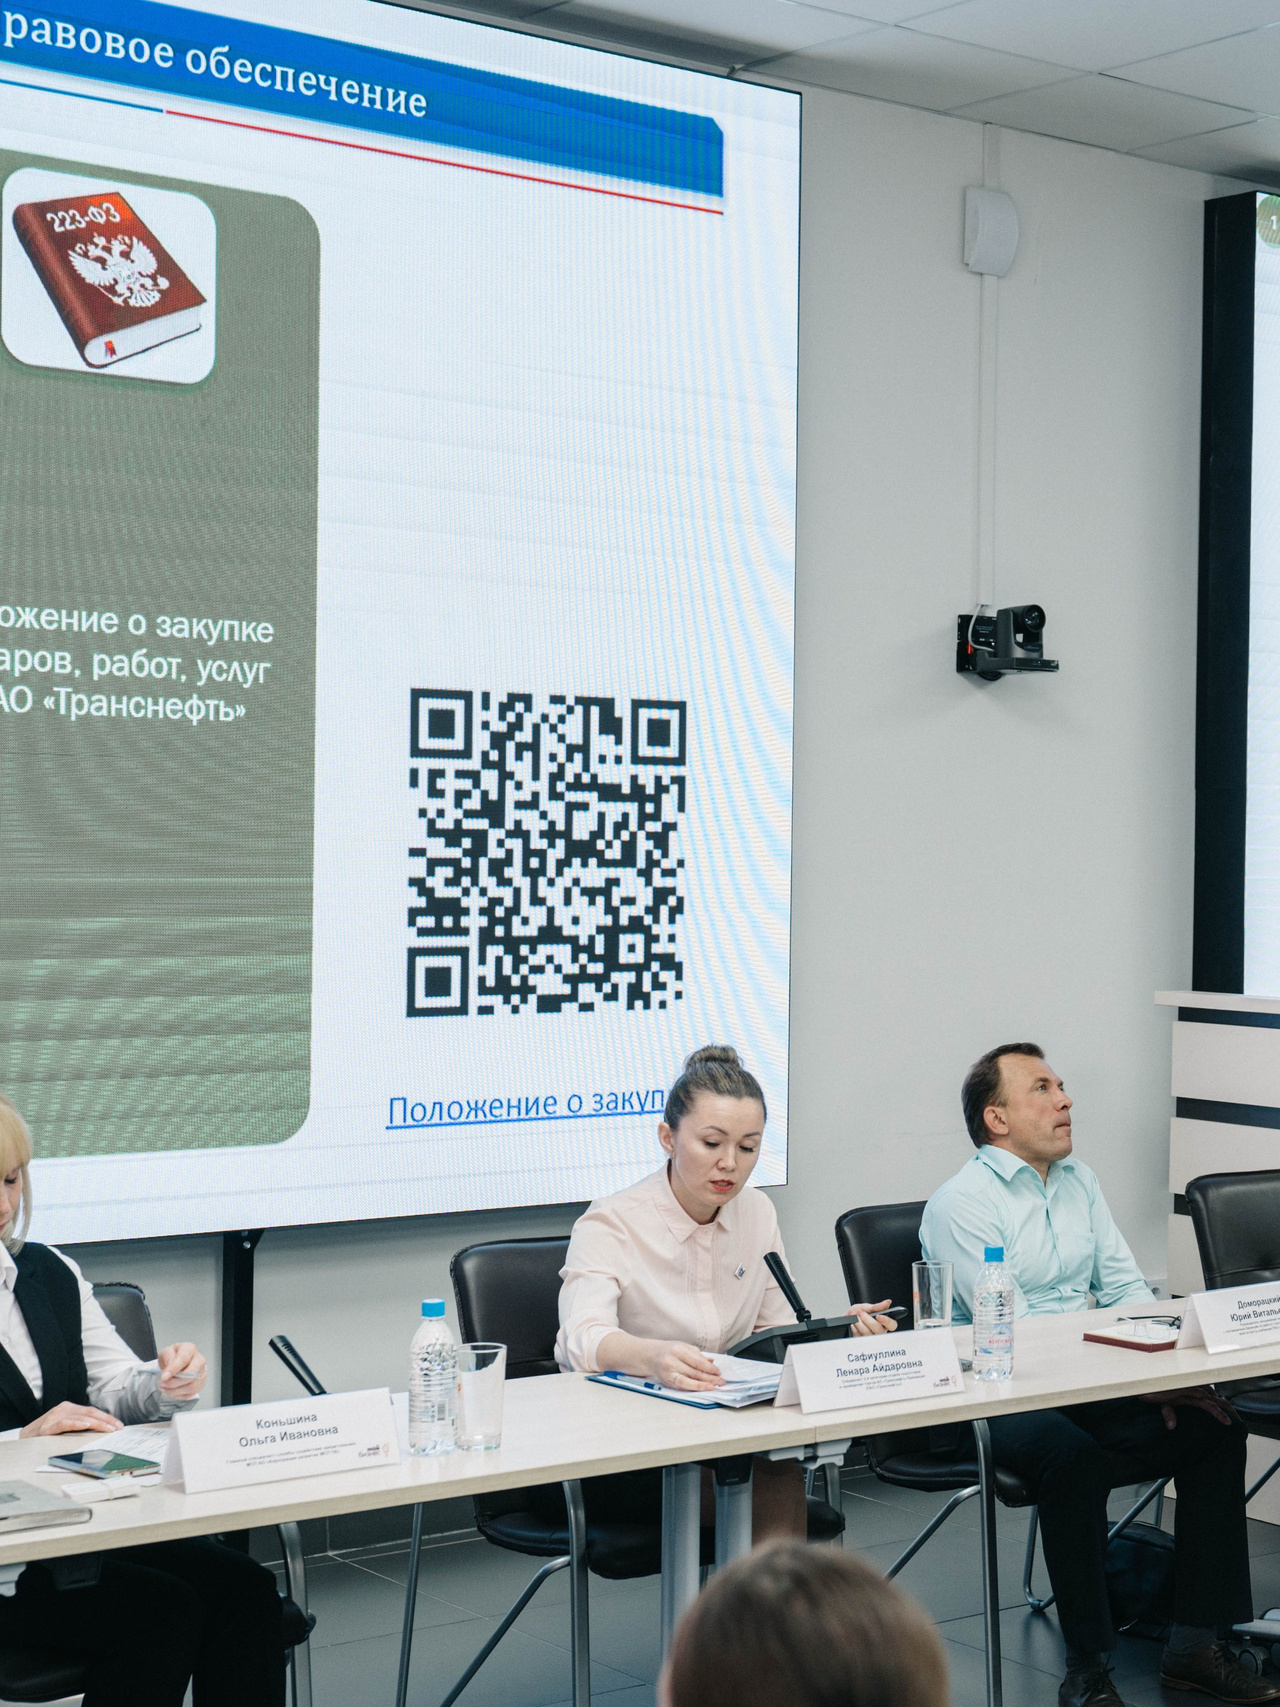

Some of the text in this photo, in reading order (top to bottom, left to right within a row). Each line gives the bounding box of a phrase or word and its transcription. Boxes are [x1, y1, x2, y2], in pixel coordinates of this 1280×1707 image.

[3, 11, 427, 117] равовое обеспечение
[46, 202, 120, 232] 223-ФЗ
[1271, 215, 1277, 230] 1
[0, 604, 275, 646] ожение о закупке
[92, 647, 187, 683] работ,
[196, 658, 272, 689] услуг
[43, 686, 246, 726] «Транснефть»
[389, 1089, 665, 1125] Положение о закуп
[1230, 1312, 1251, 1323] Юрий
[836, 1367, 870, 1378] Ленара
[872, 1358, 923, 1373] Айдаровна
[847, 1348, 906, 1363] Сафиуллина
[255, 1412, 318, 1430] Коньшина
[239, 1425, 339, 1448] Ольга Ивановна
